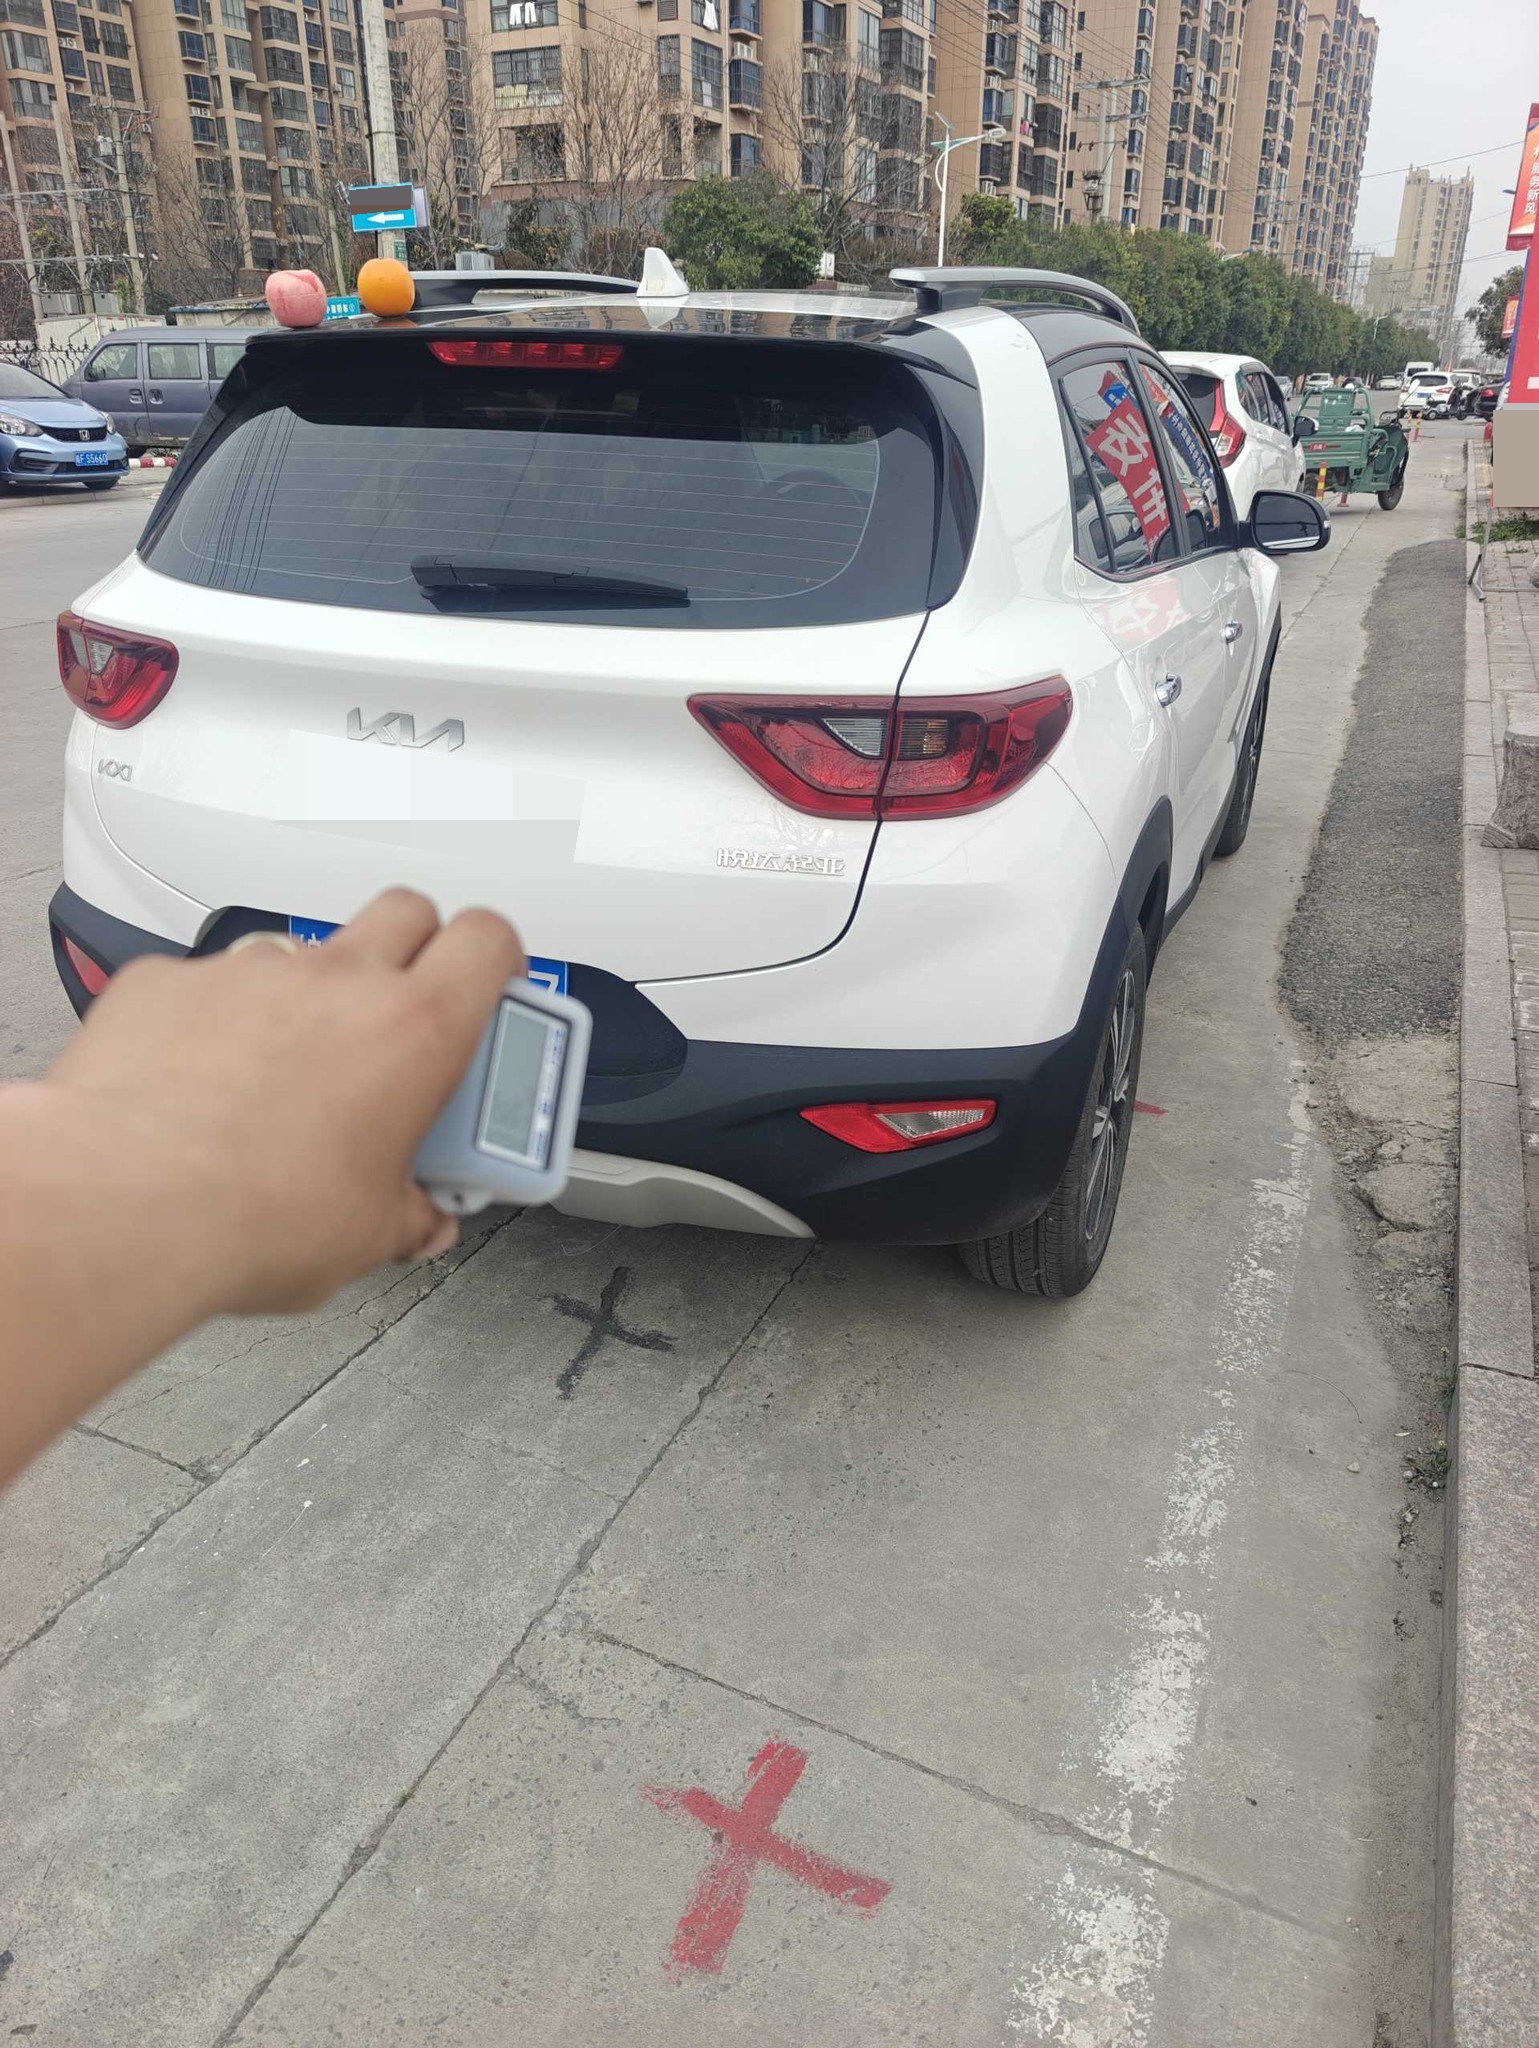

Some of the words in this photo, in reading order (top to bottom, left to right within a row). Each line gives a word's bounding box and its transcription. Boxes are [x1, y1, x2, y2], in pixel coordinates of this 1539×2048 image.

[347, 707, 464, 752] KIA
[716, 848, 846, 876] 悦达起亚
